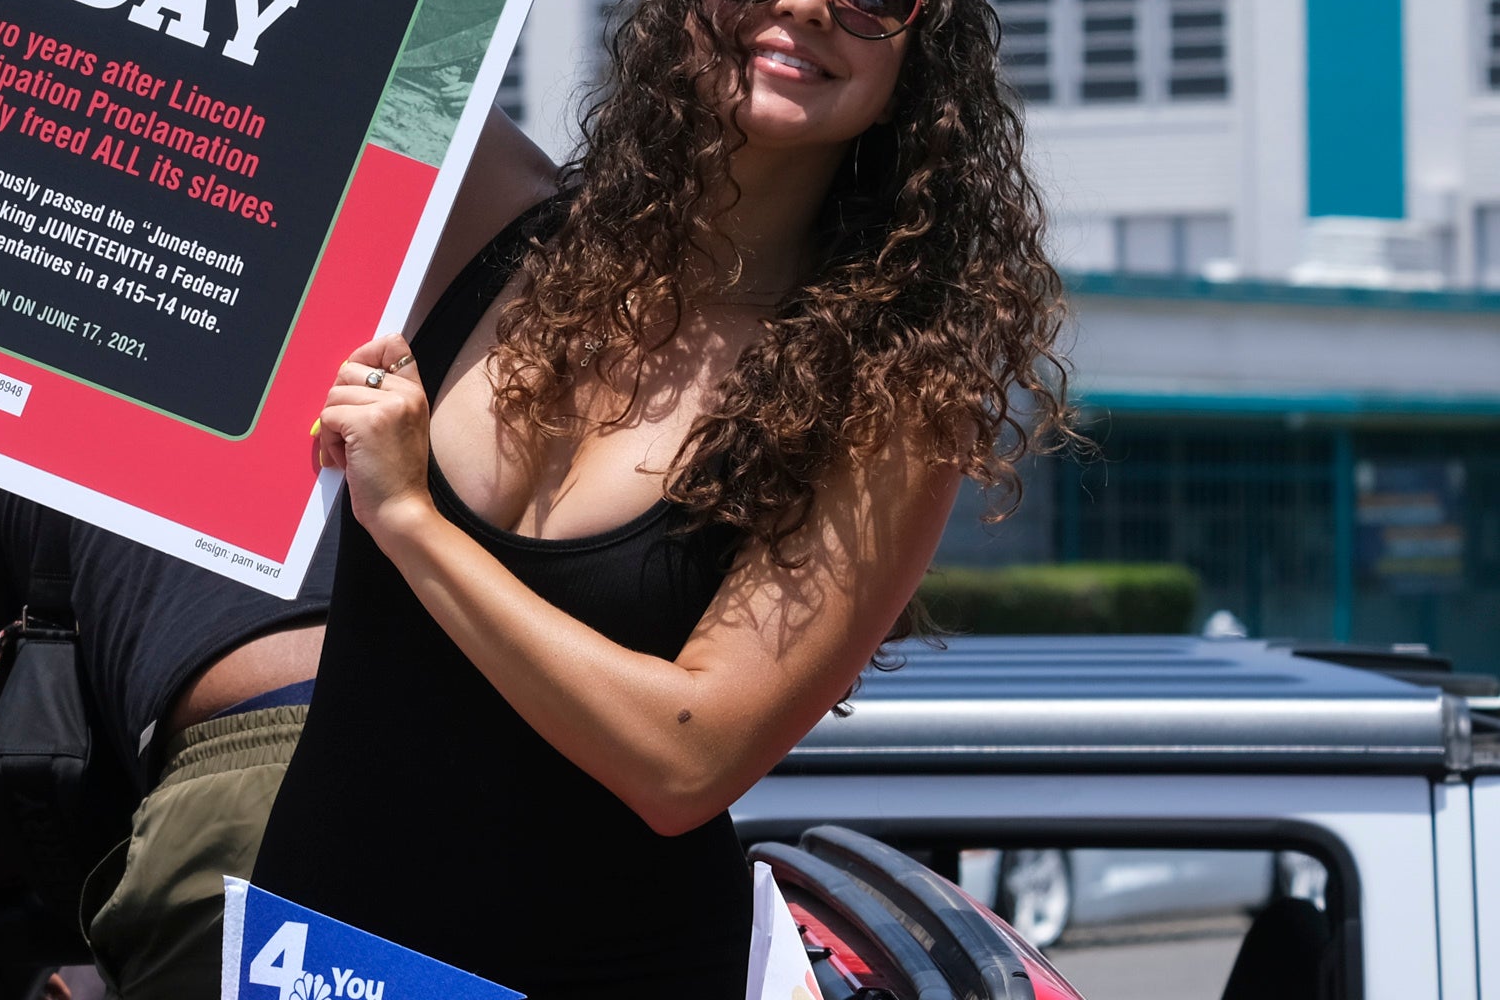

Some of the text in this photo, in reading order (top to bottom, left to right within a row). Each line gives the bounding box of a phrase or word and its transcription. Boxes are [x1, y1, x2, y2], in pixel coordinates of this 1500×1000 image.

[23, 32, 97, 75] years
[101, 61, 165, 100] after
[168, 79, 265, 138] Lincoln
[19, 106, 90, 154] freed
[91, 135, 139, 176] ALL
[149, 154, 183, 190] its
[187, 174, 276, 227] slaves.
[86, 90, 259, 177] Proclamation
[40, 188, 105, 222] passed
[106, 209, 135, 234] the
[38, 216, 154, 273] JUNETEENTH
[155, 263, 167, 279] a
[170, 265, 239, 306] Federal
[75, 261, 93, 284] in
[96, 274, 109, 290] a
[180, 304, 220, 333] vote.
[12, 295, 36, 316] ON
[36, 305, 79, 333] JUNE
[82, 322, 101, 345] 17,
[107, 331, 147, 361] 2021.
[194, 537, 281, 578] design: pam ward
[249, 921, 385, 1000] 4 You
